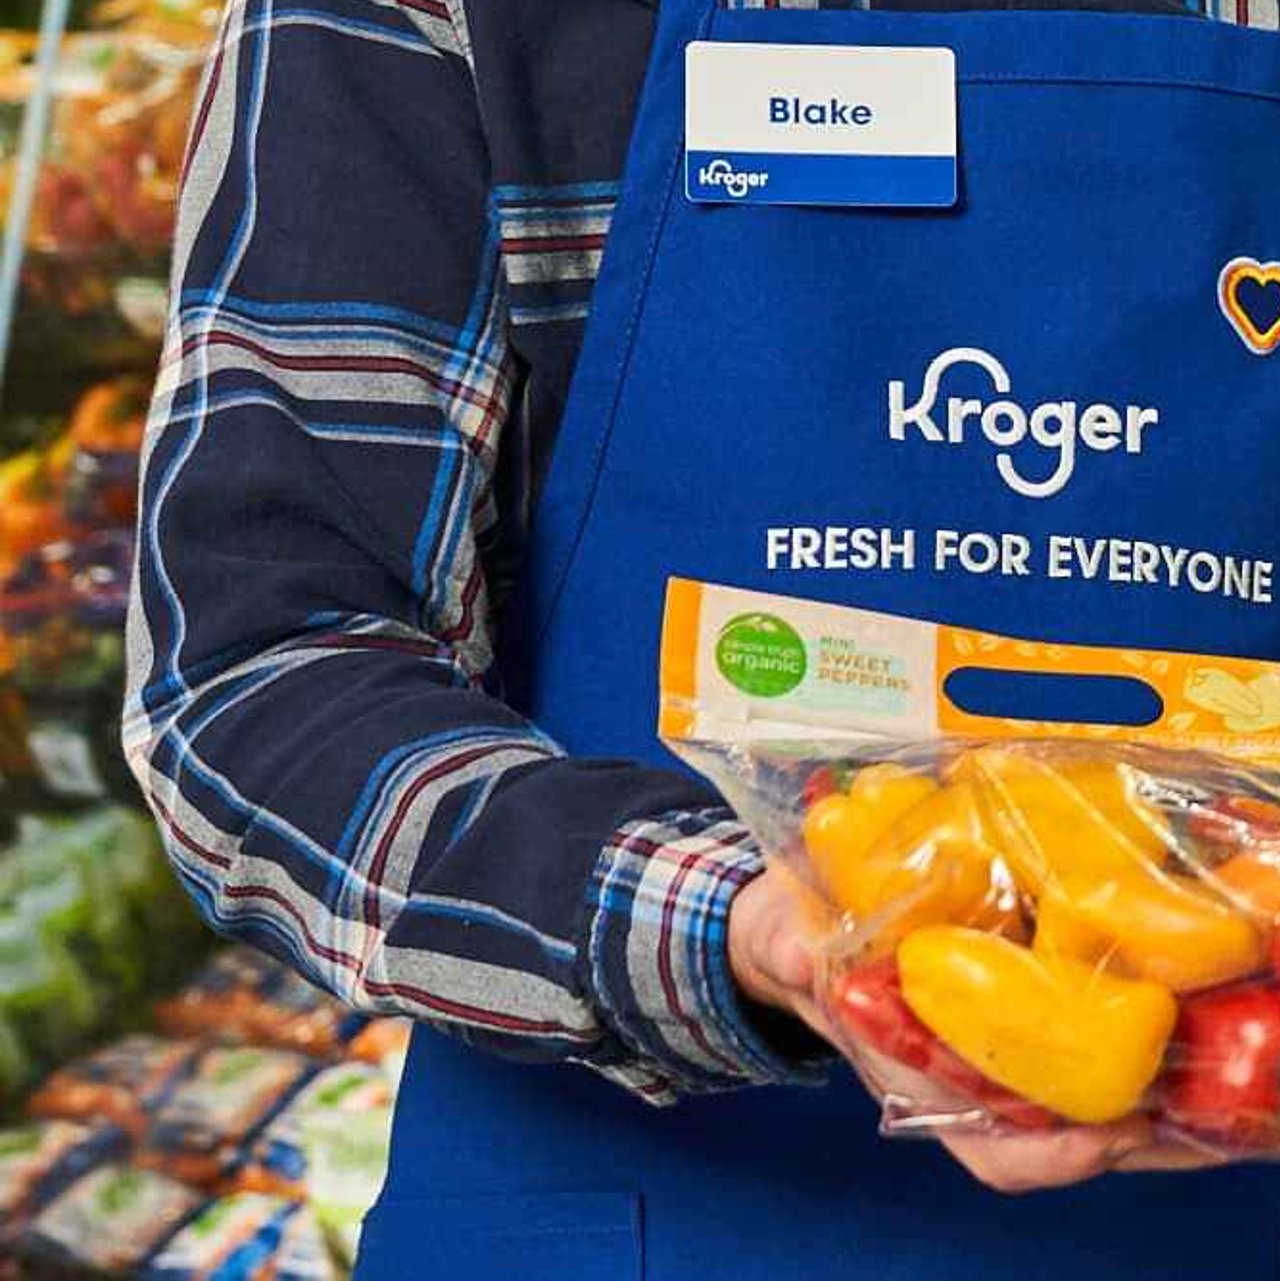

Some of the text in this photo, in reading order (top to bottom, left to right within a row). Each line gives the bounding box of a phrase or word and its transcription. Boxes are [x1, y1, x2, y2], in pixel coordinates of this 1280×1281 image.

[769, 97, 872, 126] Blake
[699, 159, 769, 198] Kroger
[888, 346, 1159, 499] Kroger
[766, 527, 1275, 604] FRESH FOR EVERYONE
[722, 652, 800, 674] organic
[821, 650, 892, 673] SWEET
[817, 668, 911, 691] PEPPERS
